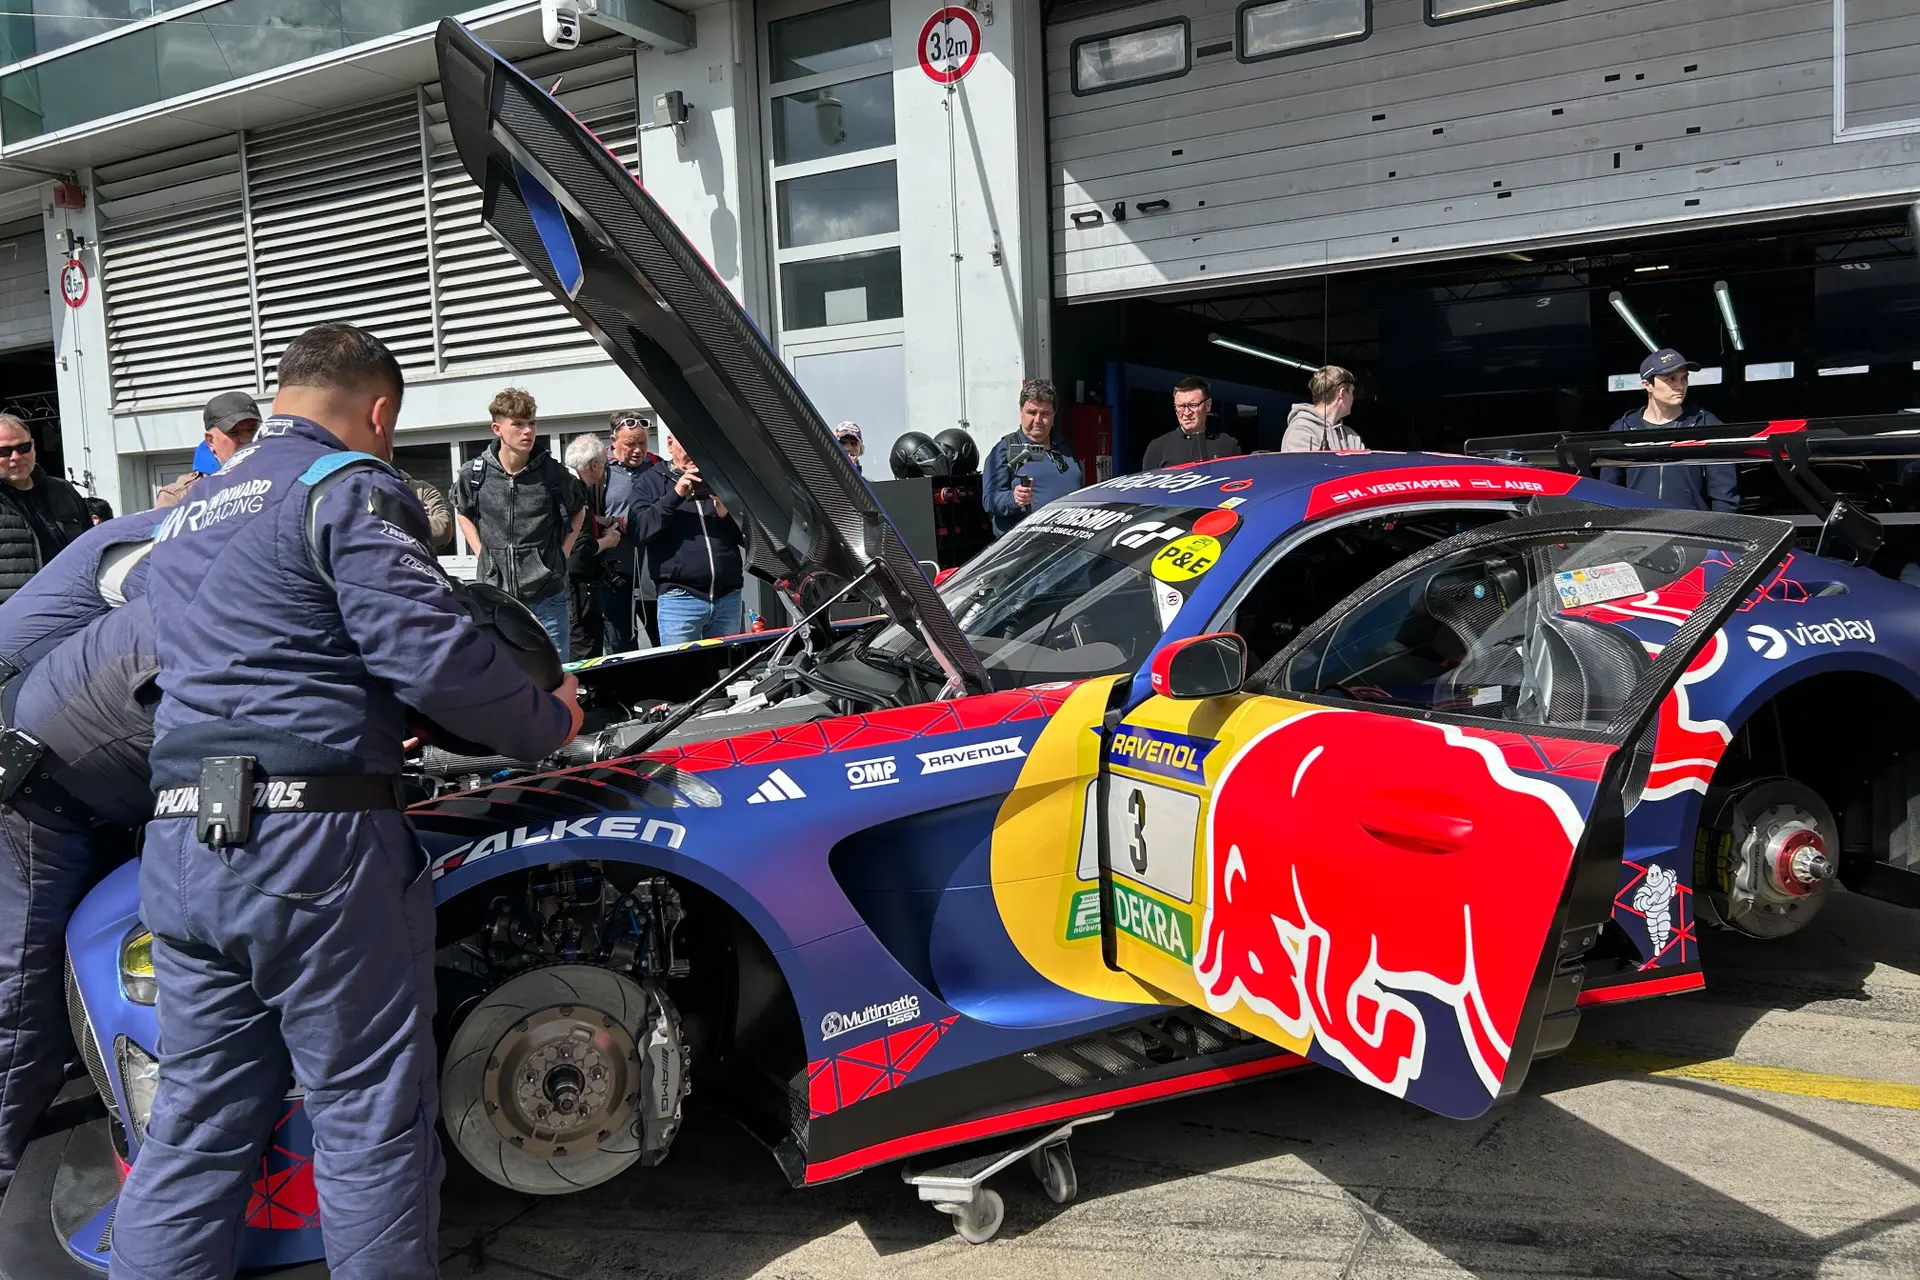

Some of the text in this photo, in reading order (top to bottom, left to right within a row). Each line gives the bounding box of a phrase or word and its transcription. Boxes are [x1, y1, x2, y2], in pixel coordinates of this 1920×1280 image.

[209, 480, 272, 509] WINWARD
[1348, 479, 1545, 499] M. VERSTAPPEN L. AUER
[202, 495, 264, 529] RACING
[1050, 527, 1095, 540] SIMULATOR
[1157, 546, 1211, 574] P&E
[1784, 618, 1876, 646] viaplay
[929, 744, 1015, 767] RAVENOL
[1111, 733, 1198, 771] RAVENOL
[847, 761, 897, 785] OMP
[154, 786, 199, 816] RACIN
[1128, 788, 1148, 876] 3
[432, 816, 687, 881] FALKEN
[1115, 887, 1187, 959] DEKRA
[843, 994, 919, 1029] Multimatic
[887, 1009, 921, 1028] DSSV
